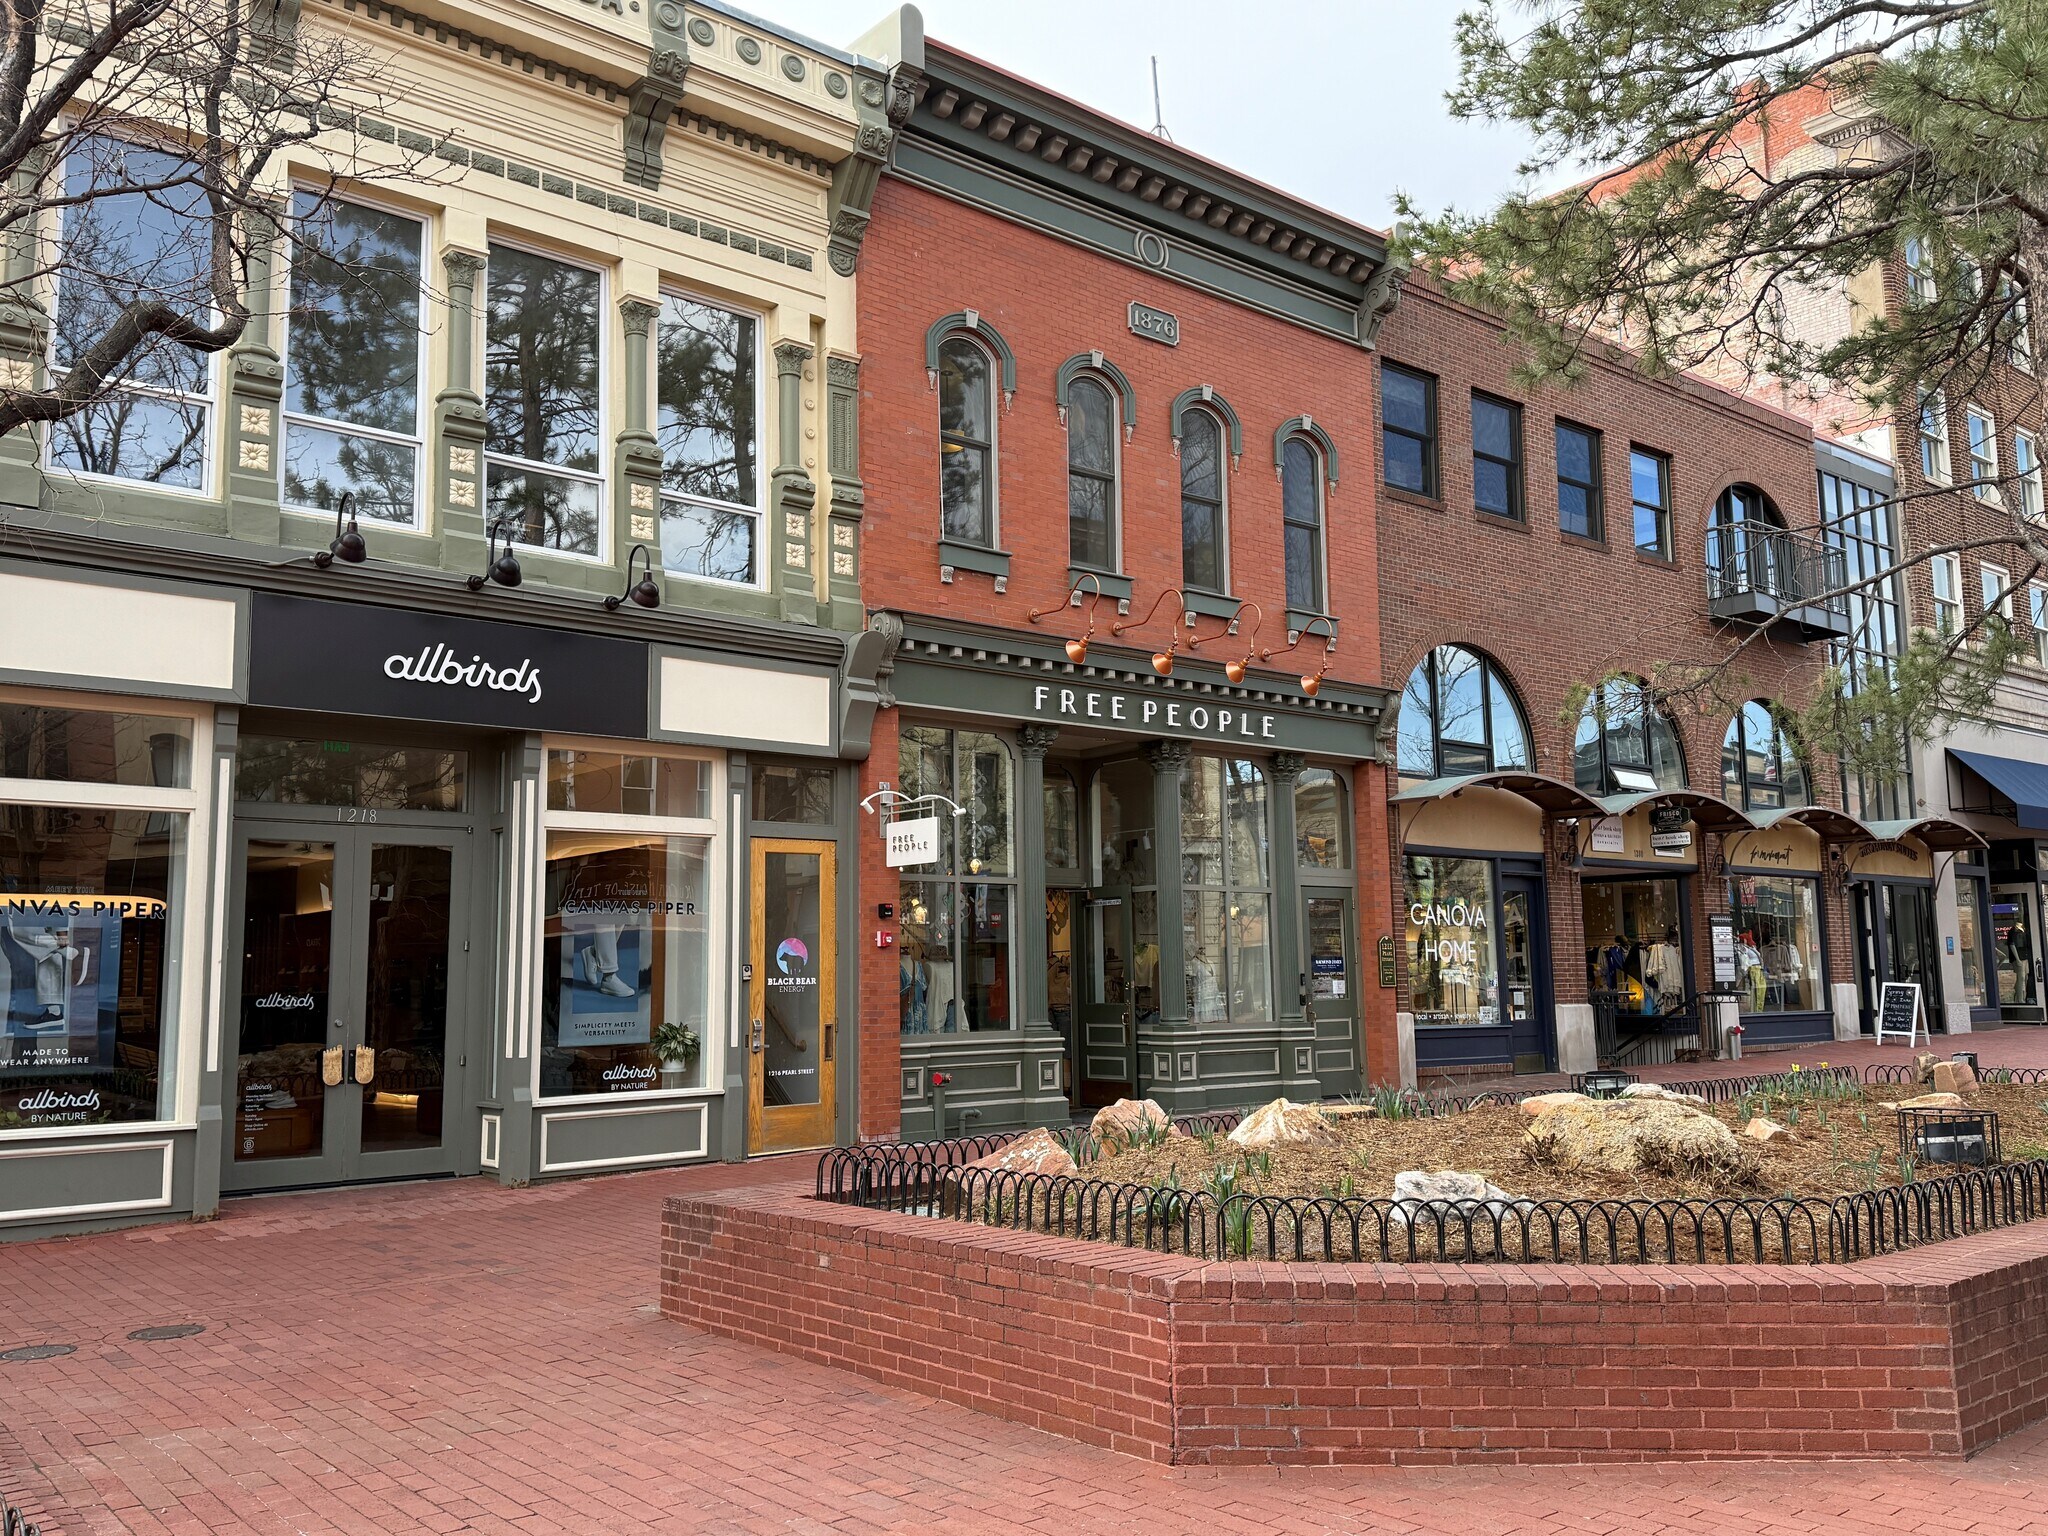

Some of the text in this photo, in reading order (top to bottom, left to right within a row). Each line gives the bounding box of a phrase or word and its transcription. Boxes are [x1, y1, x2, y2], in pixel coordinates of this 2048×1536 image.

[1133, 308, 1176, 338] 1876
[383, 643, 542, 704] allbirds
[1034, 686, 1276, 738] FREE PEOPLE
[337, 807, 377, 824] 1218
[892, 834, 929, 853] FREE PEOPLE
[75, 886, 95, 894] THE
[0, 898, 165, 920] NVAS PIPER
[565, 899, 696, 916] CANVAS PIPER
[1410, 903, 1487, 928] CANOVA
[1425, 939, 1477, 962] HOME
[767, 977, 817, 986] BLACK BEAR
[779, 985, 806, 993] ENERGY
[255, 992, 315, 1011] allbirds
[1416, 1012, 1428, 1021] local
[1432, 1012, 1450, 1020] artisan
[574, 1022, 612, 1030] SIMPLICITY
[584, 1029, 626, 1037] VERSATILITY
[0, 1056, 89, 1066] WEAR ANYWHERE
[602, 1063, 657, 1081] allbirds
[245, 1082, 273, 1091] allbirds
[610, 1082, 648, 1091] BY NATURE
[18, 1088, 100, 1111] allbirds
[31, 1111, 87, 1123] BY NATURE
